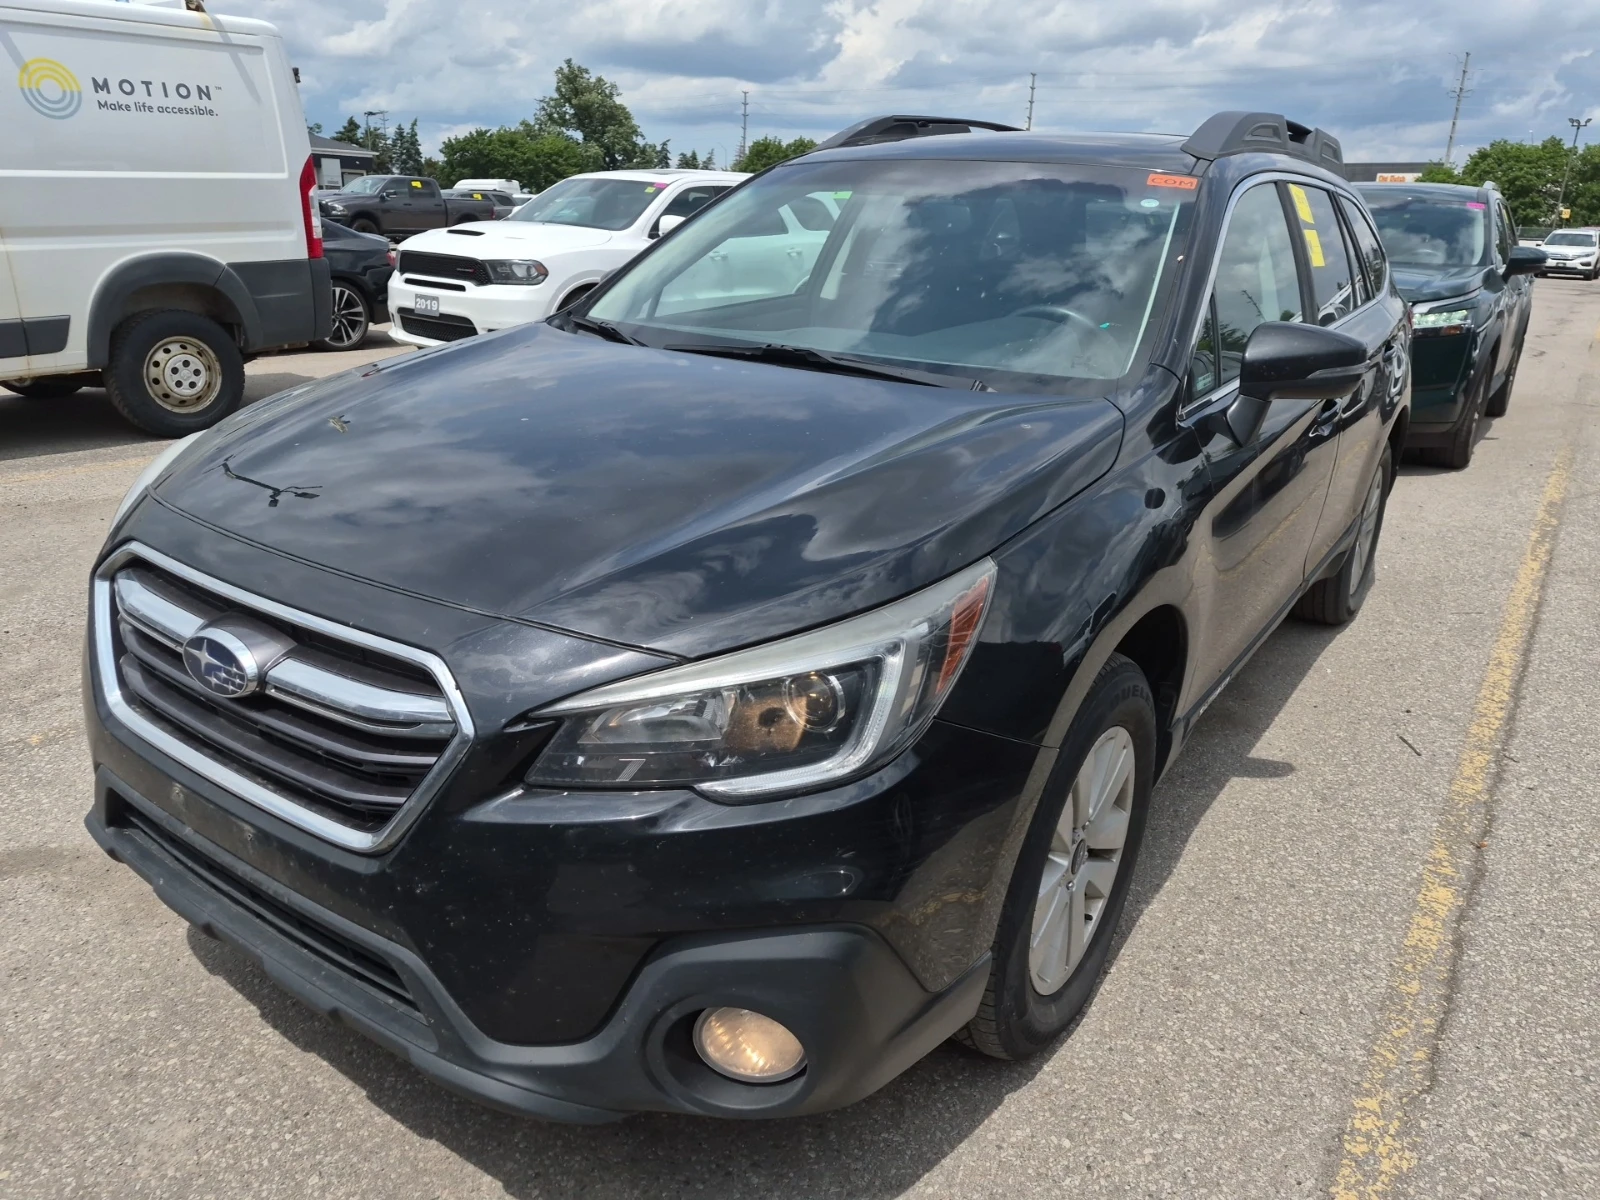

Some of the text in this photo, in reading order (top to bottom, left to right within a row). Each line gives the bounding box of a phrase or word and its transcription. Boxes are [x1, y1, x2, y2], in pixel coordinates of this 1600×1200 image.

[91, 76, 212, 101] MOTION
[97, 100, 219, 116] Make life accessible.
[1151, 177, 1194, 188] COM
[415, 298, 438, 311] 2019
